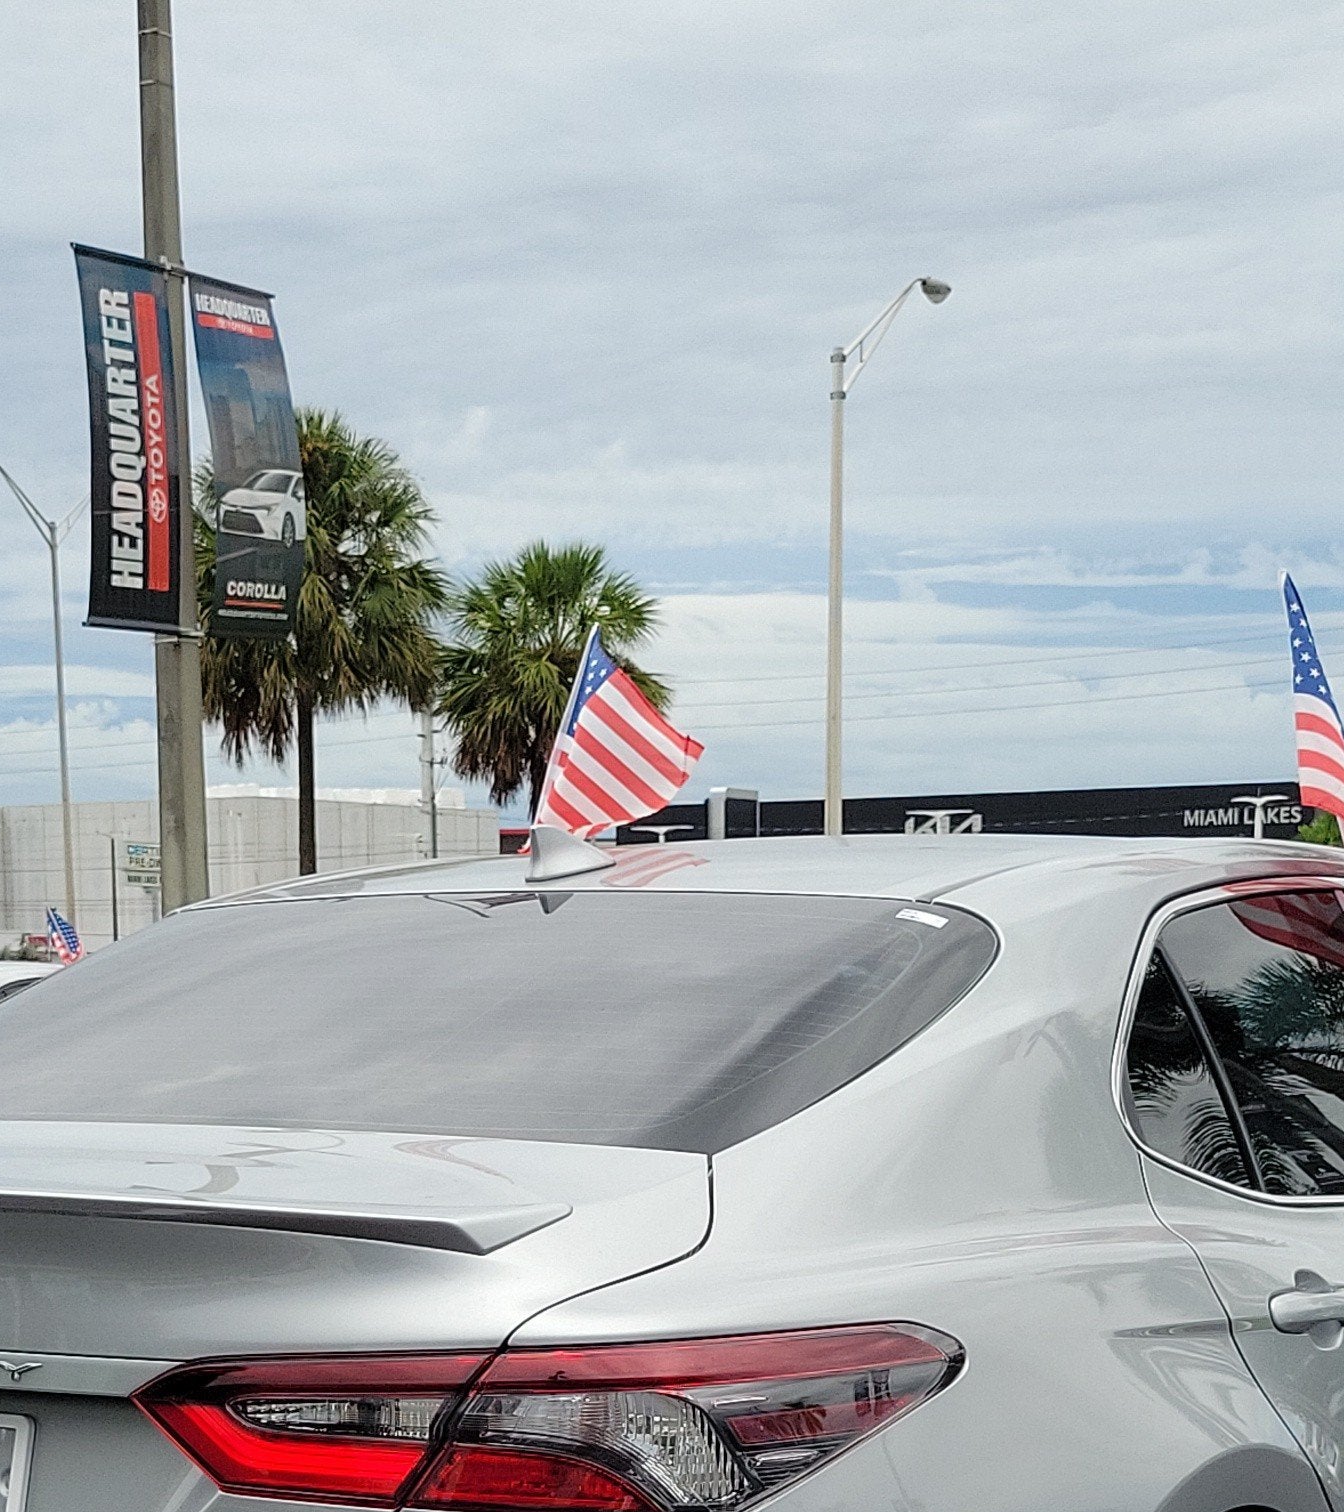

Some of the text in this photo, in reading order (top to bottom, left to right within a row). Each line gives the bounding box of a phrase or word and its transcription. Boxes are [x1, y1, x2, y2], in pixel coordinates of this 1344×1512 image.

[99, 287, 147, 591] HEADQUARTER
[145, 373, 165, 482] TOYOTA
[226, 581, 287, 600] COROLLA
[1183, 807, 1238, 827] MIAMI
